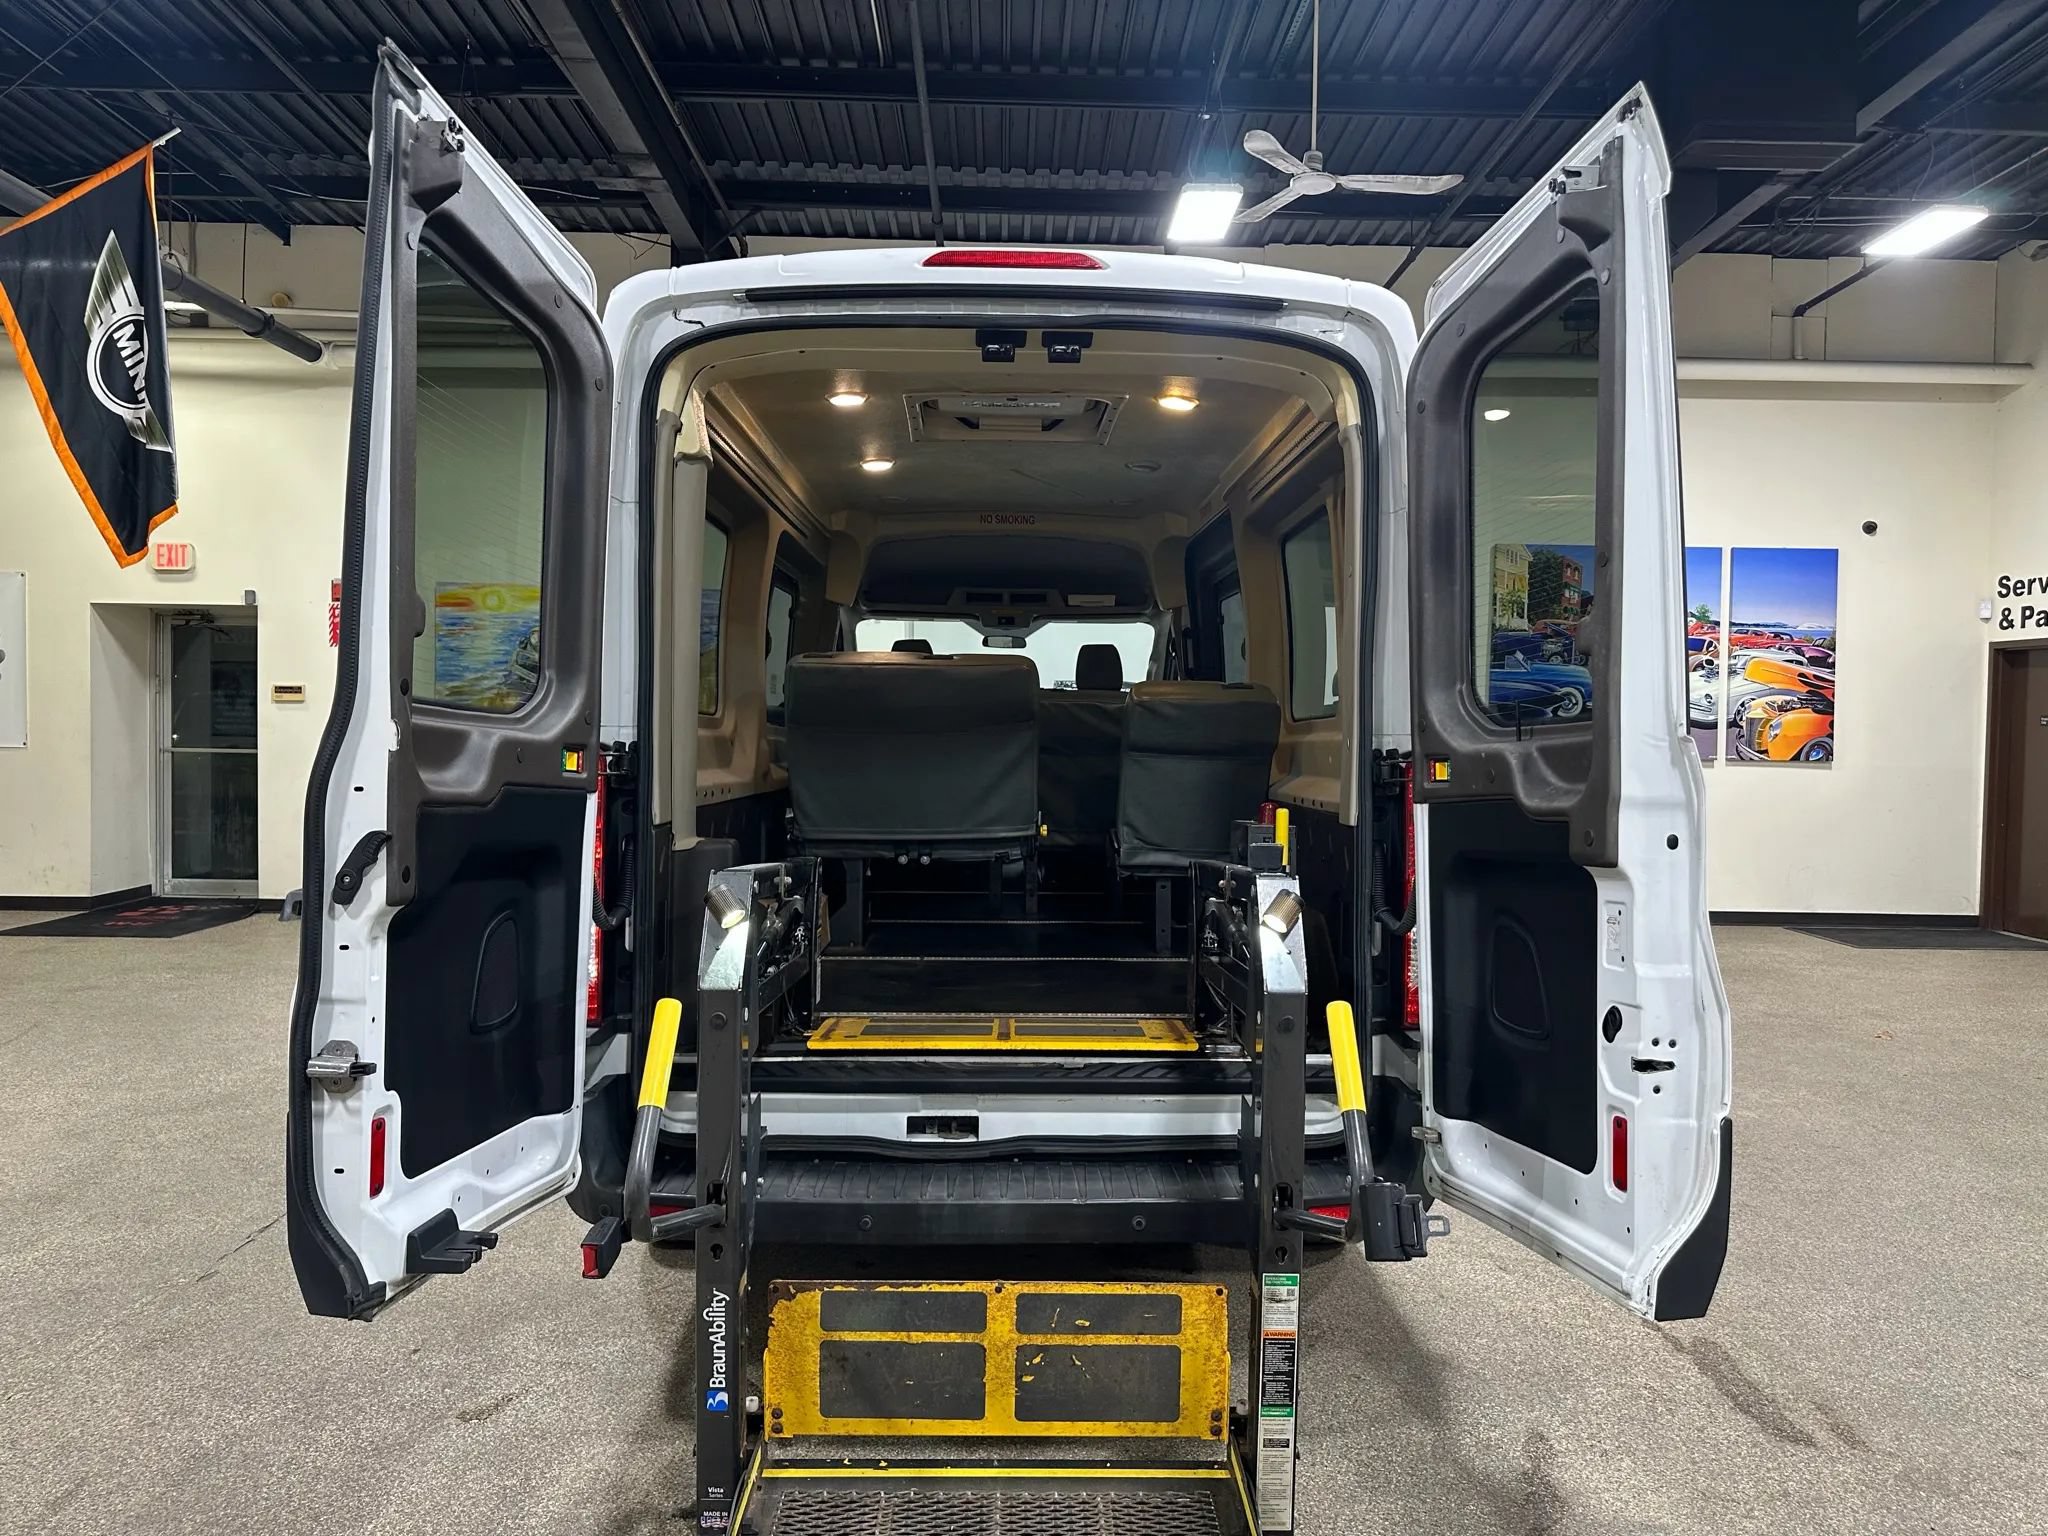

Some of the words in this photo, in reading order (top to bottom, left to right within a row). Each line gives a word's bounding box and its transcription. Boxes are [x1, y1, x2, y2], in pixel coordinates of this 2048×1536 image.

[980, 514, 993, 524] NO
[994, 514, 1036, 525] SMOKING
[156, 543, 188, 567] EXIT
[1997, 575, 2048, 598] Serv
[1998, 607, 2015, 630] &
[2020, 605, 2048, 628] Pa
[702, 1287, 730, 1388] BraunAbility
